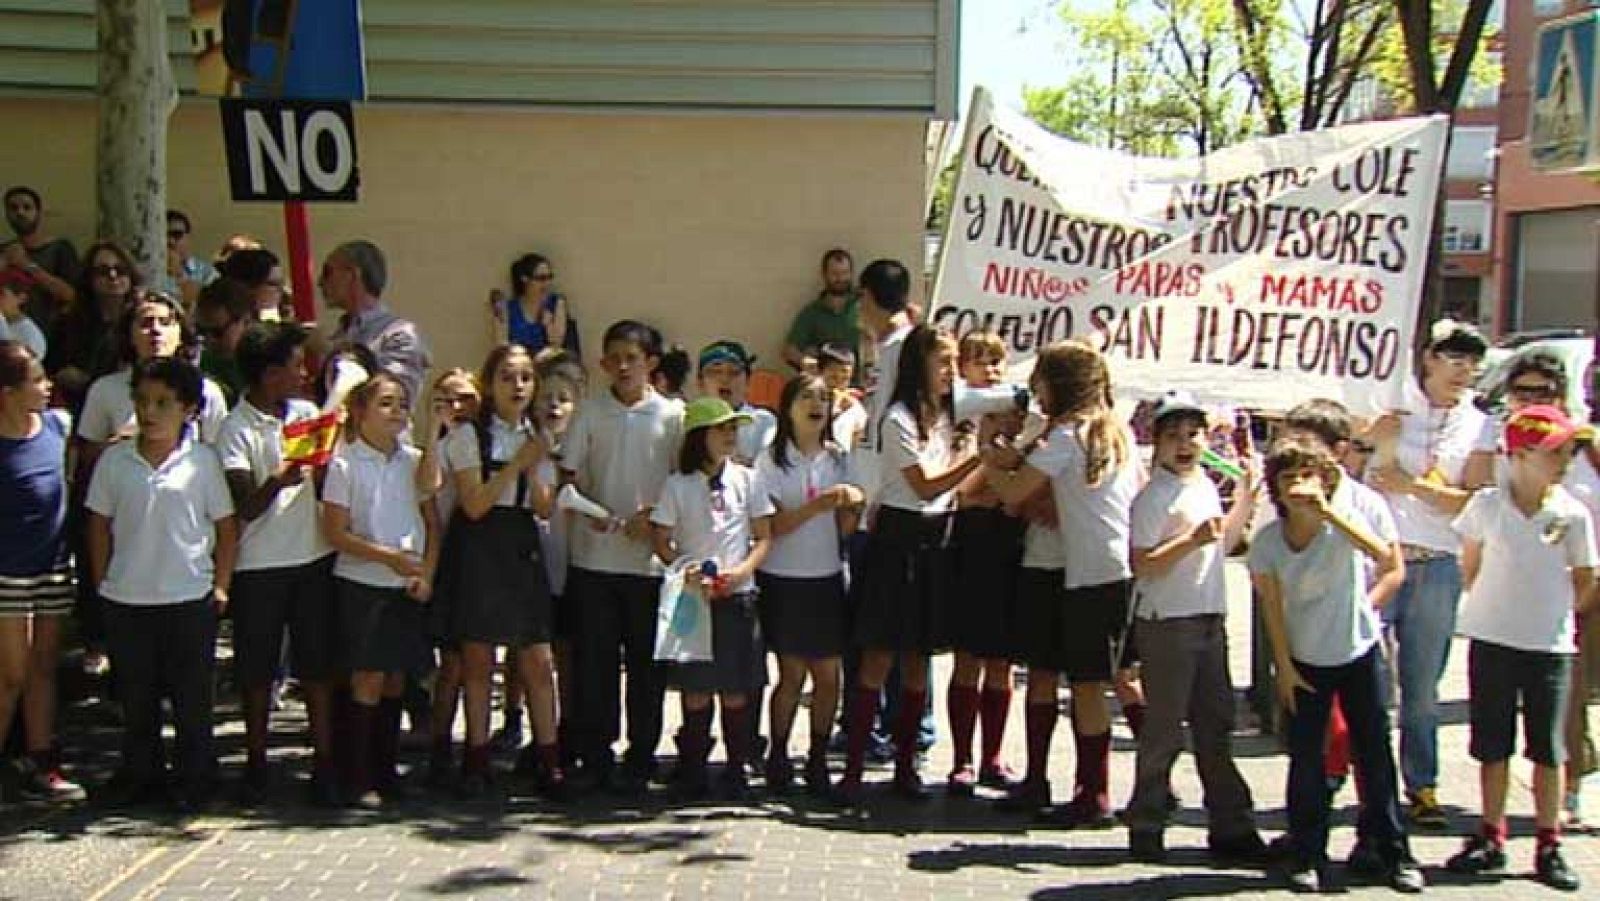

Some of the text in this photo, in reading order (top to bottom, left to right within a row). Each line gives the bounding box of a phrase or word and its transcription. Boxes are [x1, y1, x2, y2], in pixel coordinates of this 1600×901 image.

[244, 109, 353, 193] NO
[1090, 303, 1165, 361] SAN
[1191, 305, 1399, 380] ILDEFONSO
